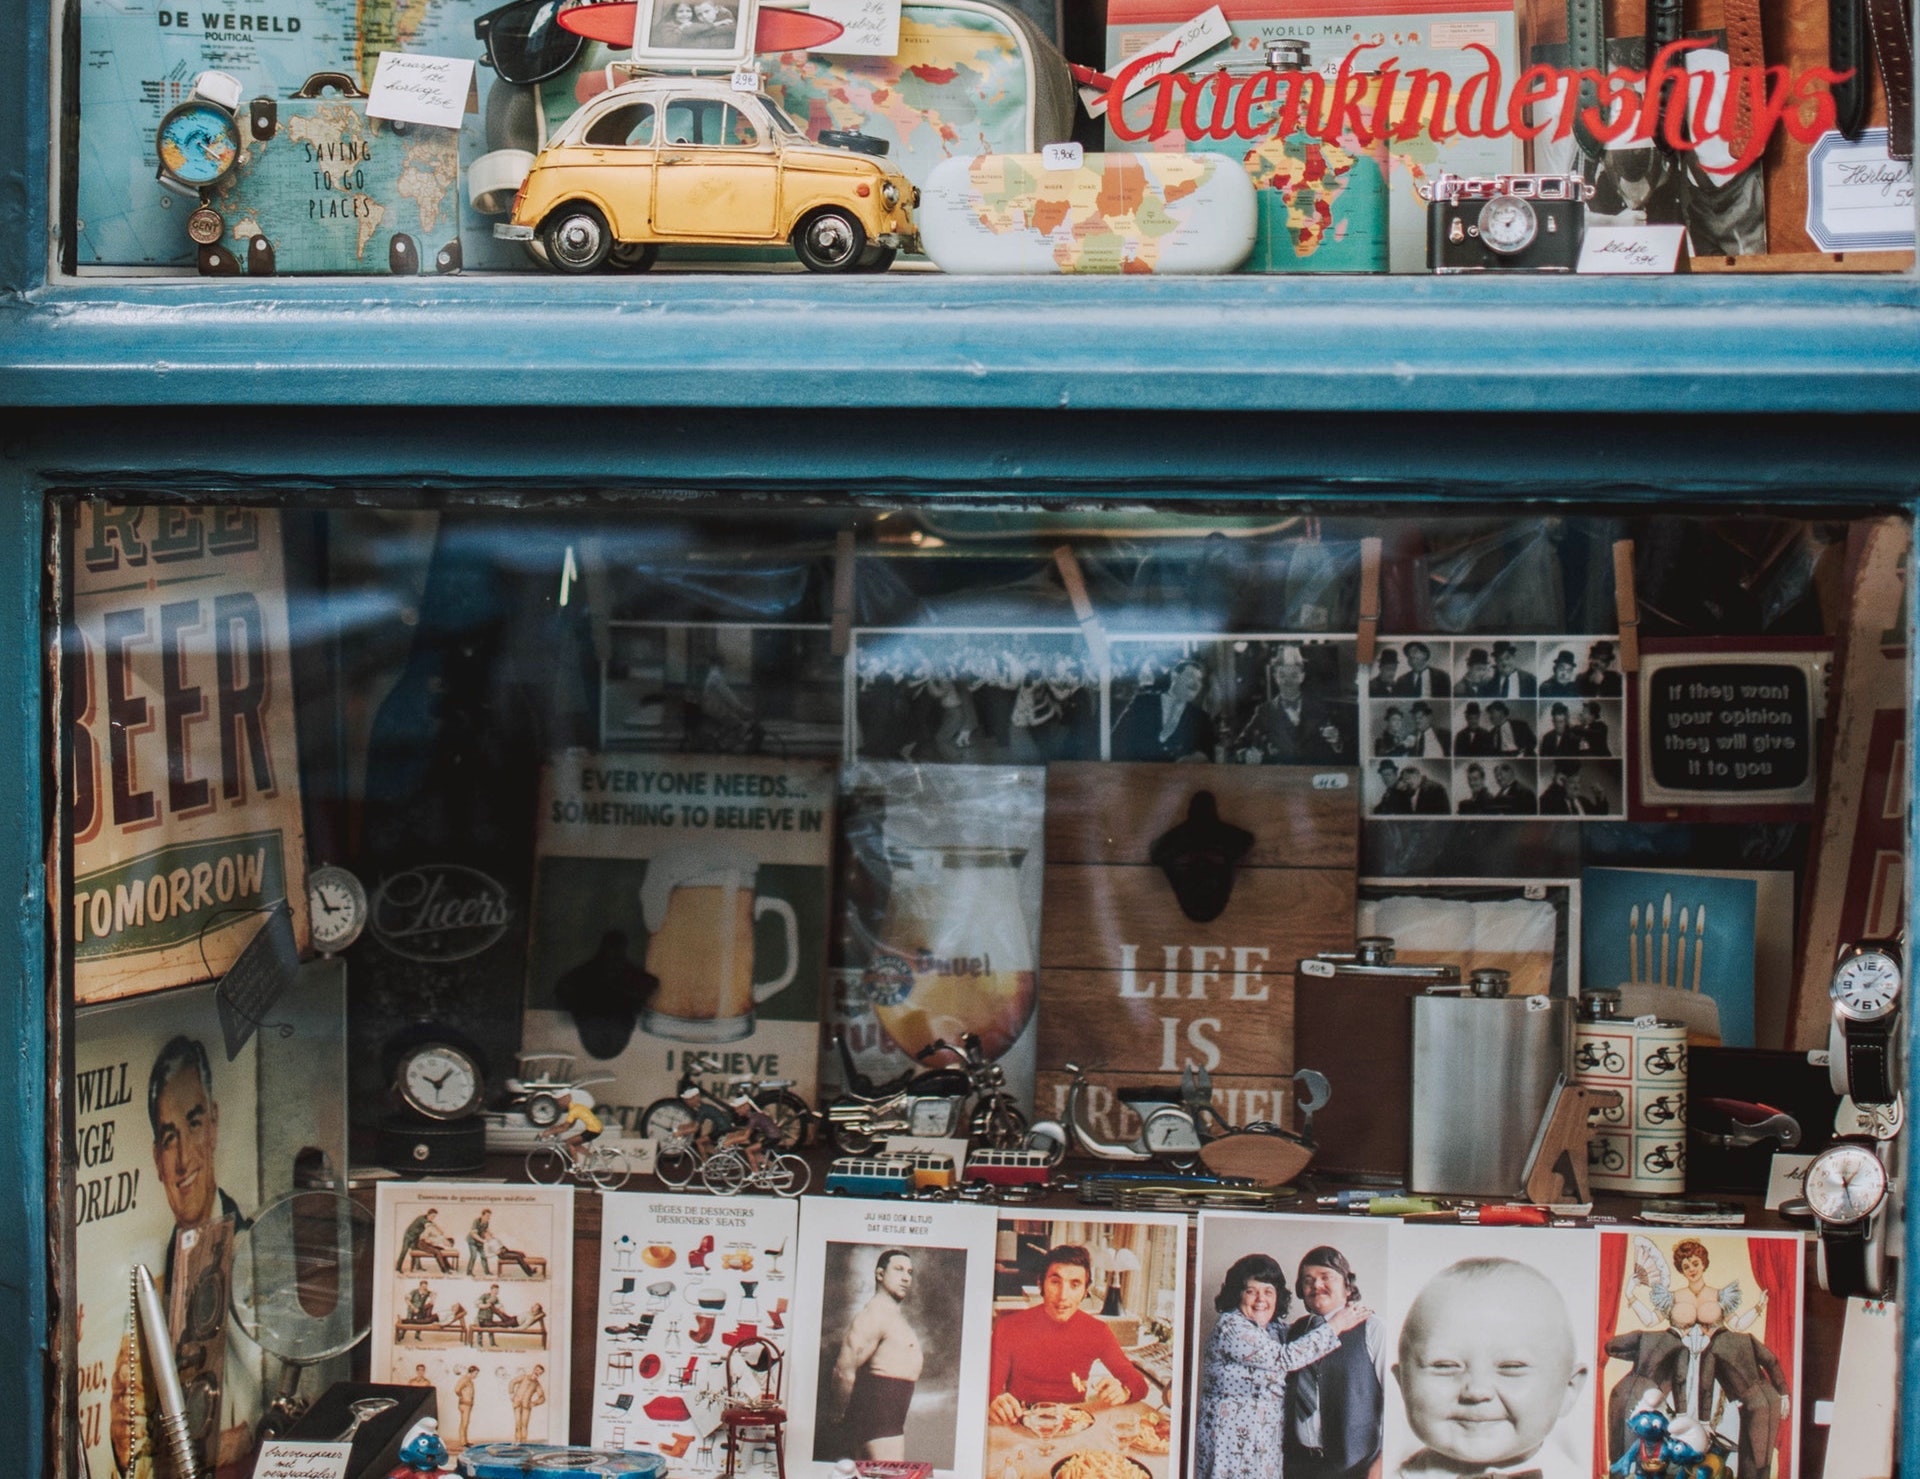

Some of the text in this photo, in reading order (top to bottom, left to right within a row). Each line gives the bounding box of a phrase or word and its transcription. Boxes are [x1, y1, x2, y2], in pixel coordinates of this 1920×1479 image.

[158, 11, 301, 32] DE WERELD
[1262, 24, 1352, 36] WORLD MAP
[204, 32, 255, 42] POLITICAL
[734, 76, 756, 88] 29€
[305, 141, 372, 163] SAVING
[313, 169, 365, 191] TO GO
[309, 197, 371, 219] PLACES
[76, 500, 261, 573] REE
[1688, 683, 1734, 702] they
[1740, 684, 1790, 699] want
[1667, 707, 1792, 729] your opinion
[1664, 733, 1796, 754] they will give
[1707, 759, 1729, 776] to
[1734, 762, 1772, 779] you
[581, 767, 708, 796] EVERYONE
[552, 803, 822, 832] SOMETHING TO BELIEVE IN
[74, 847, 265, 942] TOMORROW
[1118, 943, 1270, 1001] LIFE
[1159, 1017, 1222, 1073] IS
[76, 1062, 133, 1115] WILL
[75, 1168, 140, 1228] ORLD!
[648, 1203, 755, 1217] SIÈGES DE DESIGNERS
[716, 1216, 746, 1227] SEATS
